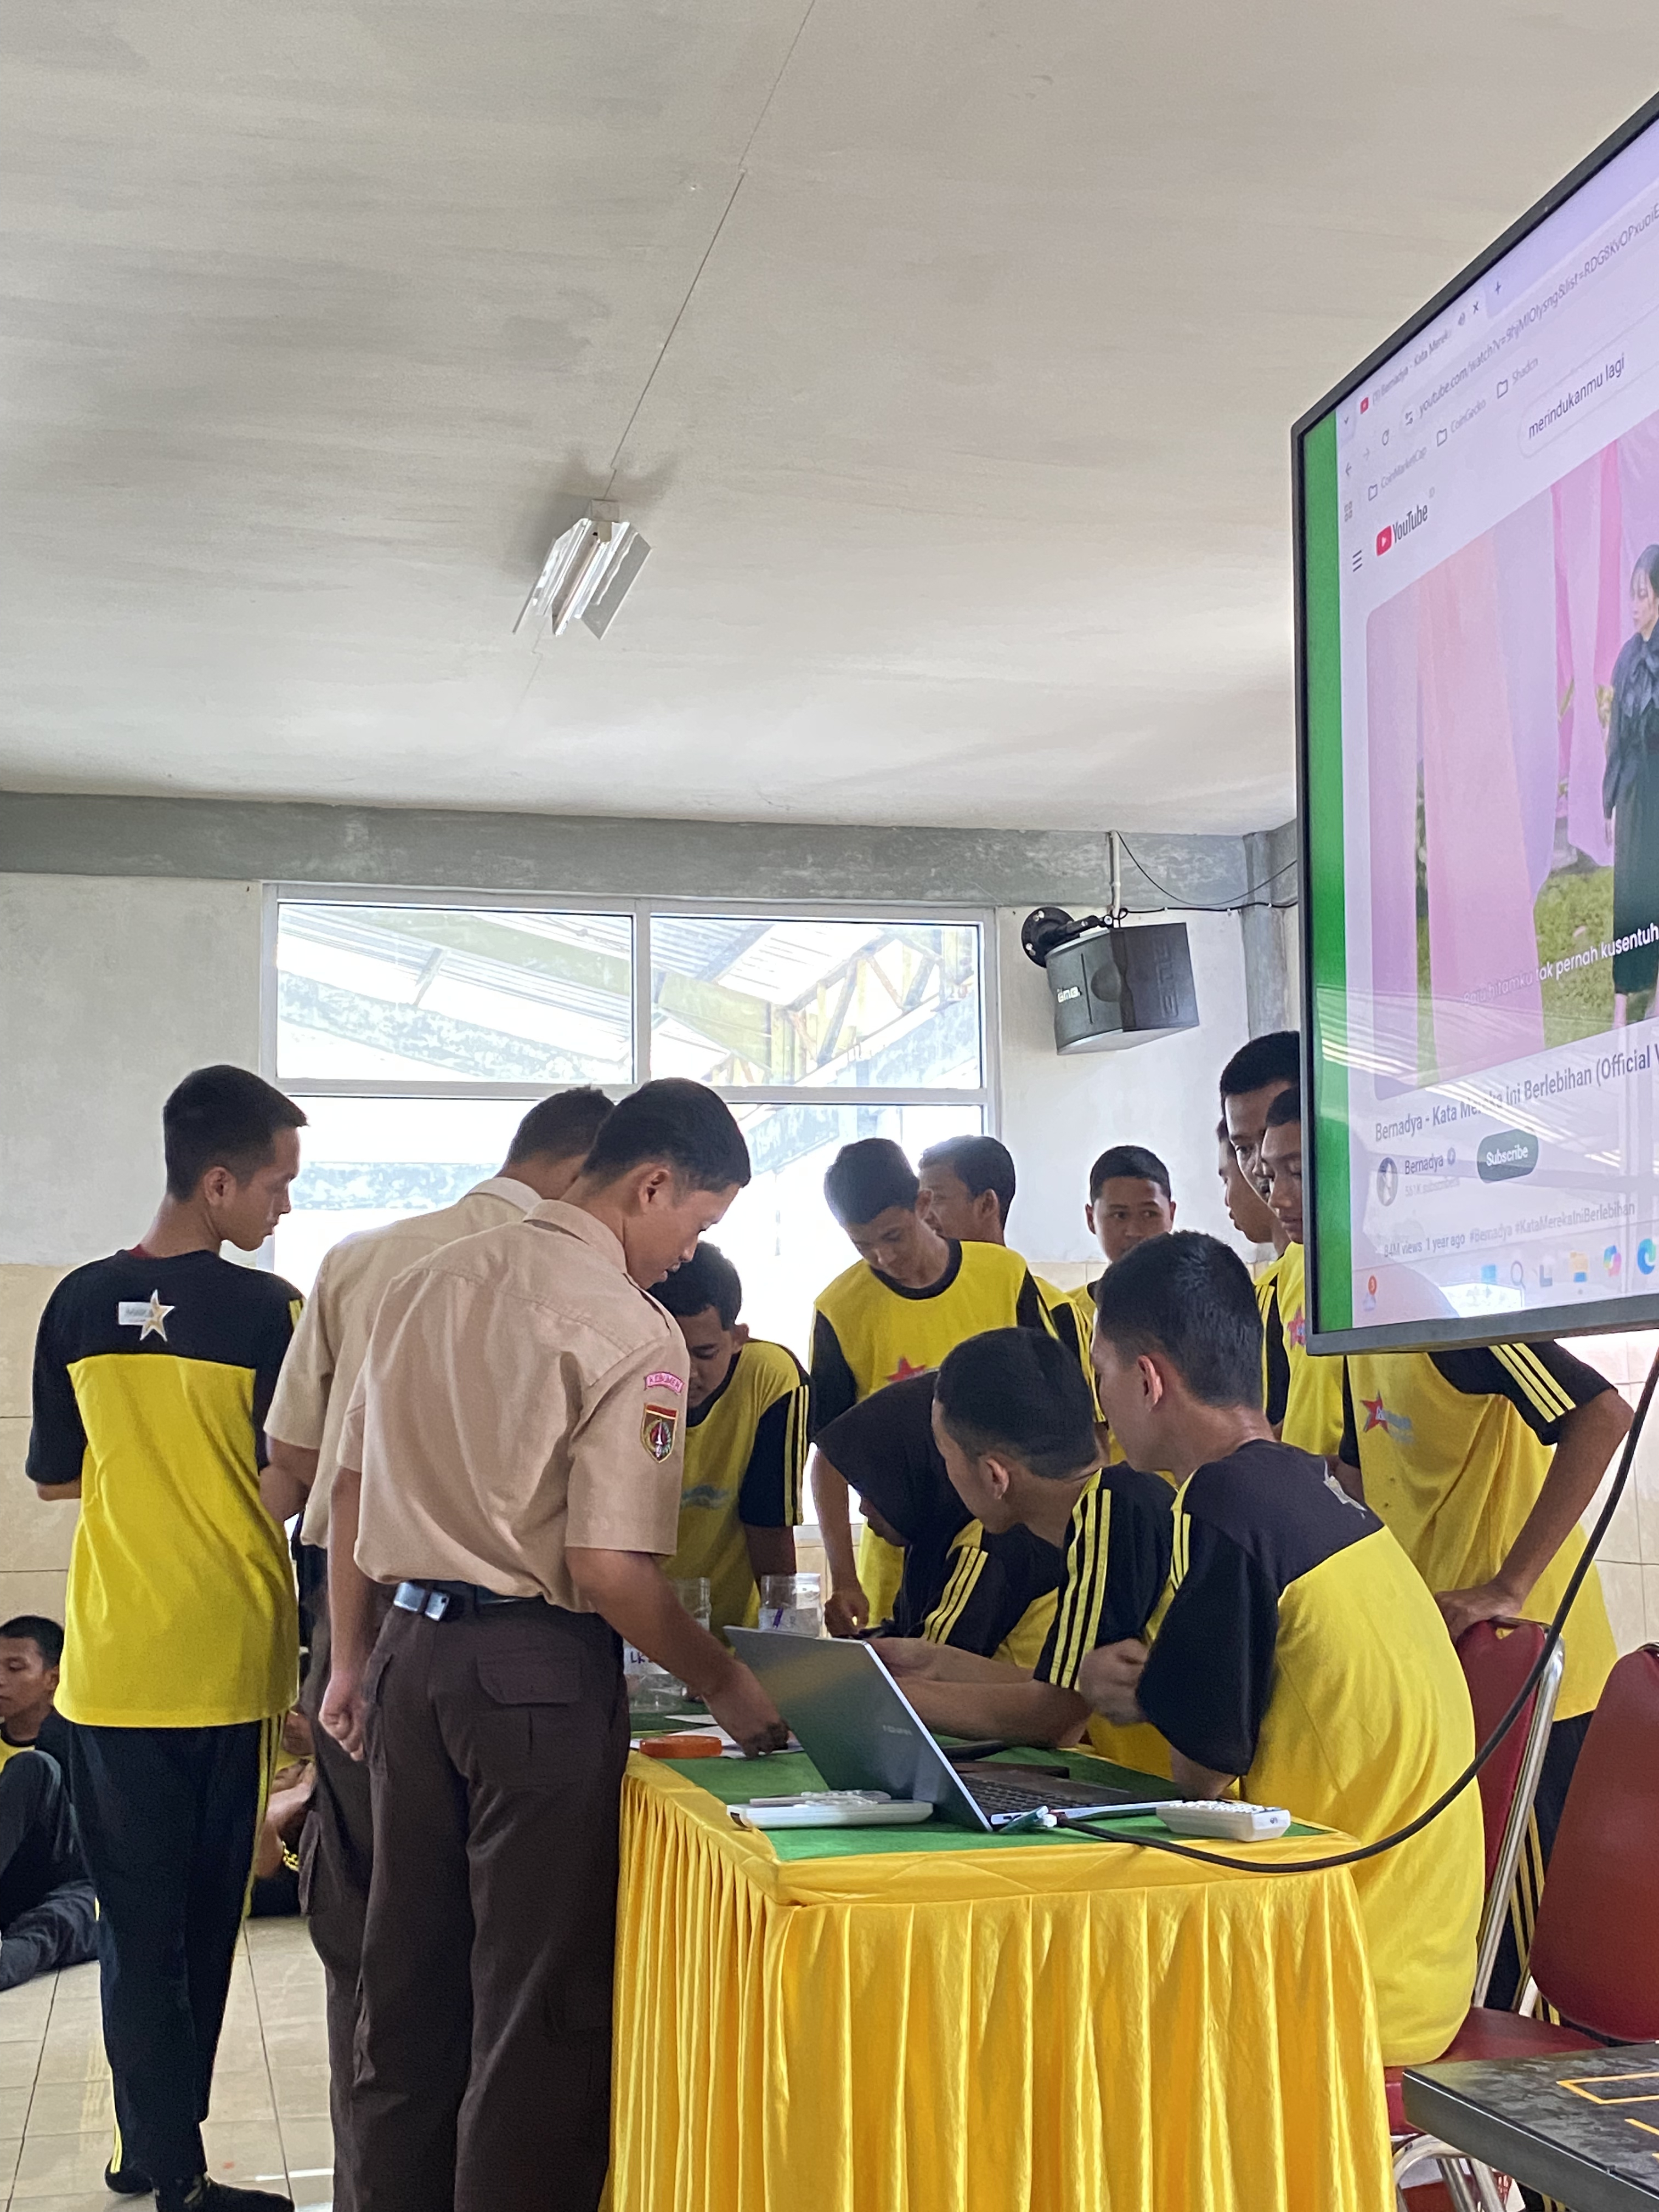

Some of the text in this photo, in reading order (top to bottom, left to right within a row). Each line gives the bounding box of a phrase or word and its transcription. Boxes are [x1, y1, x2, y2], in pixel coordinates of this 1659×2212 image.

[1528, 352, 1624, 439] merindukanmu lagi
[1392, 504, 1427, 543] YouTube
[1487, 972, 1533, 1000] hitamku
[1536, 961, 1553, 982] tak
[1556, 946, 1598, 980] pernah
[1601, 923, 1659, 958] kusentuh
[1375, 1113, 1422, 1142] Bernadya
[1432, 1104, 1458, 1126] Kata
[1524, 1067, 1592, 1101] Berlebihan
[1596, 1045, 1650, 1087] (Official
[1404, 1144, 1529, 1175] Bernadya Subscribe
[1402, 1239, 1423, 1255] views
[1426, 1237, 1431, 1251] 1
[1432, 1237, 1449, 1253] year
[1451, 1233, 1465, 1249] ago
[1470, 1223, 1513, 1244] #Bernadya
